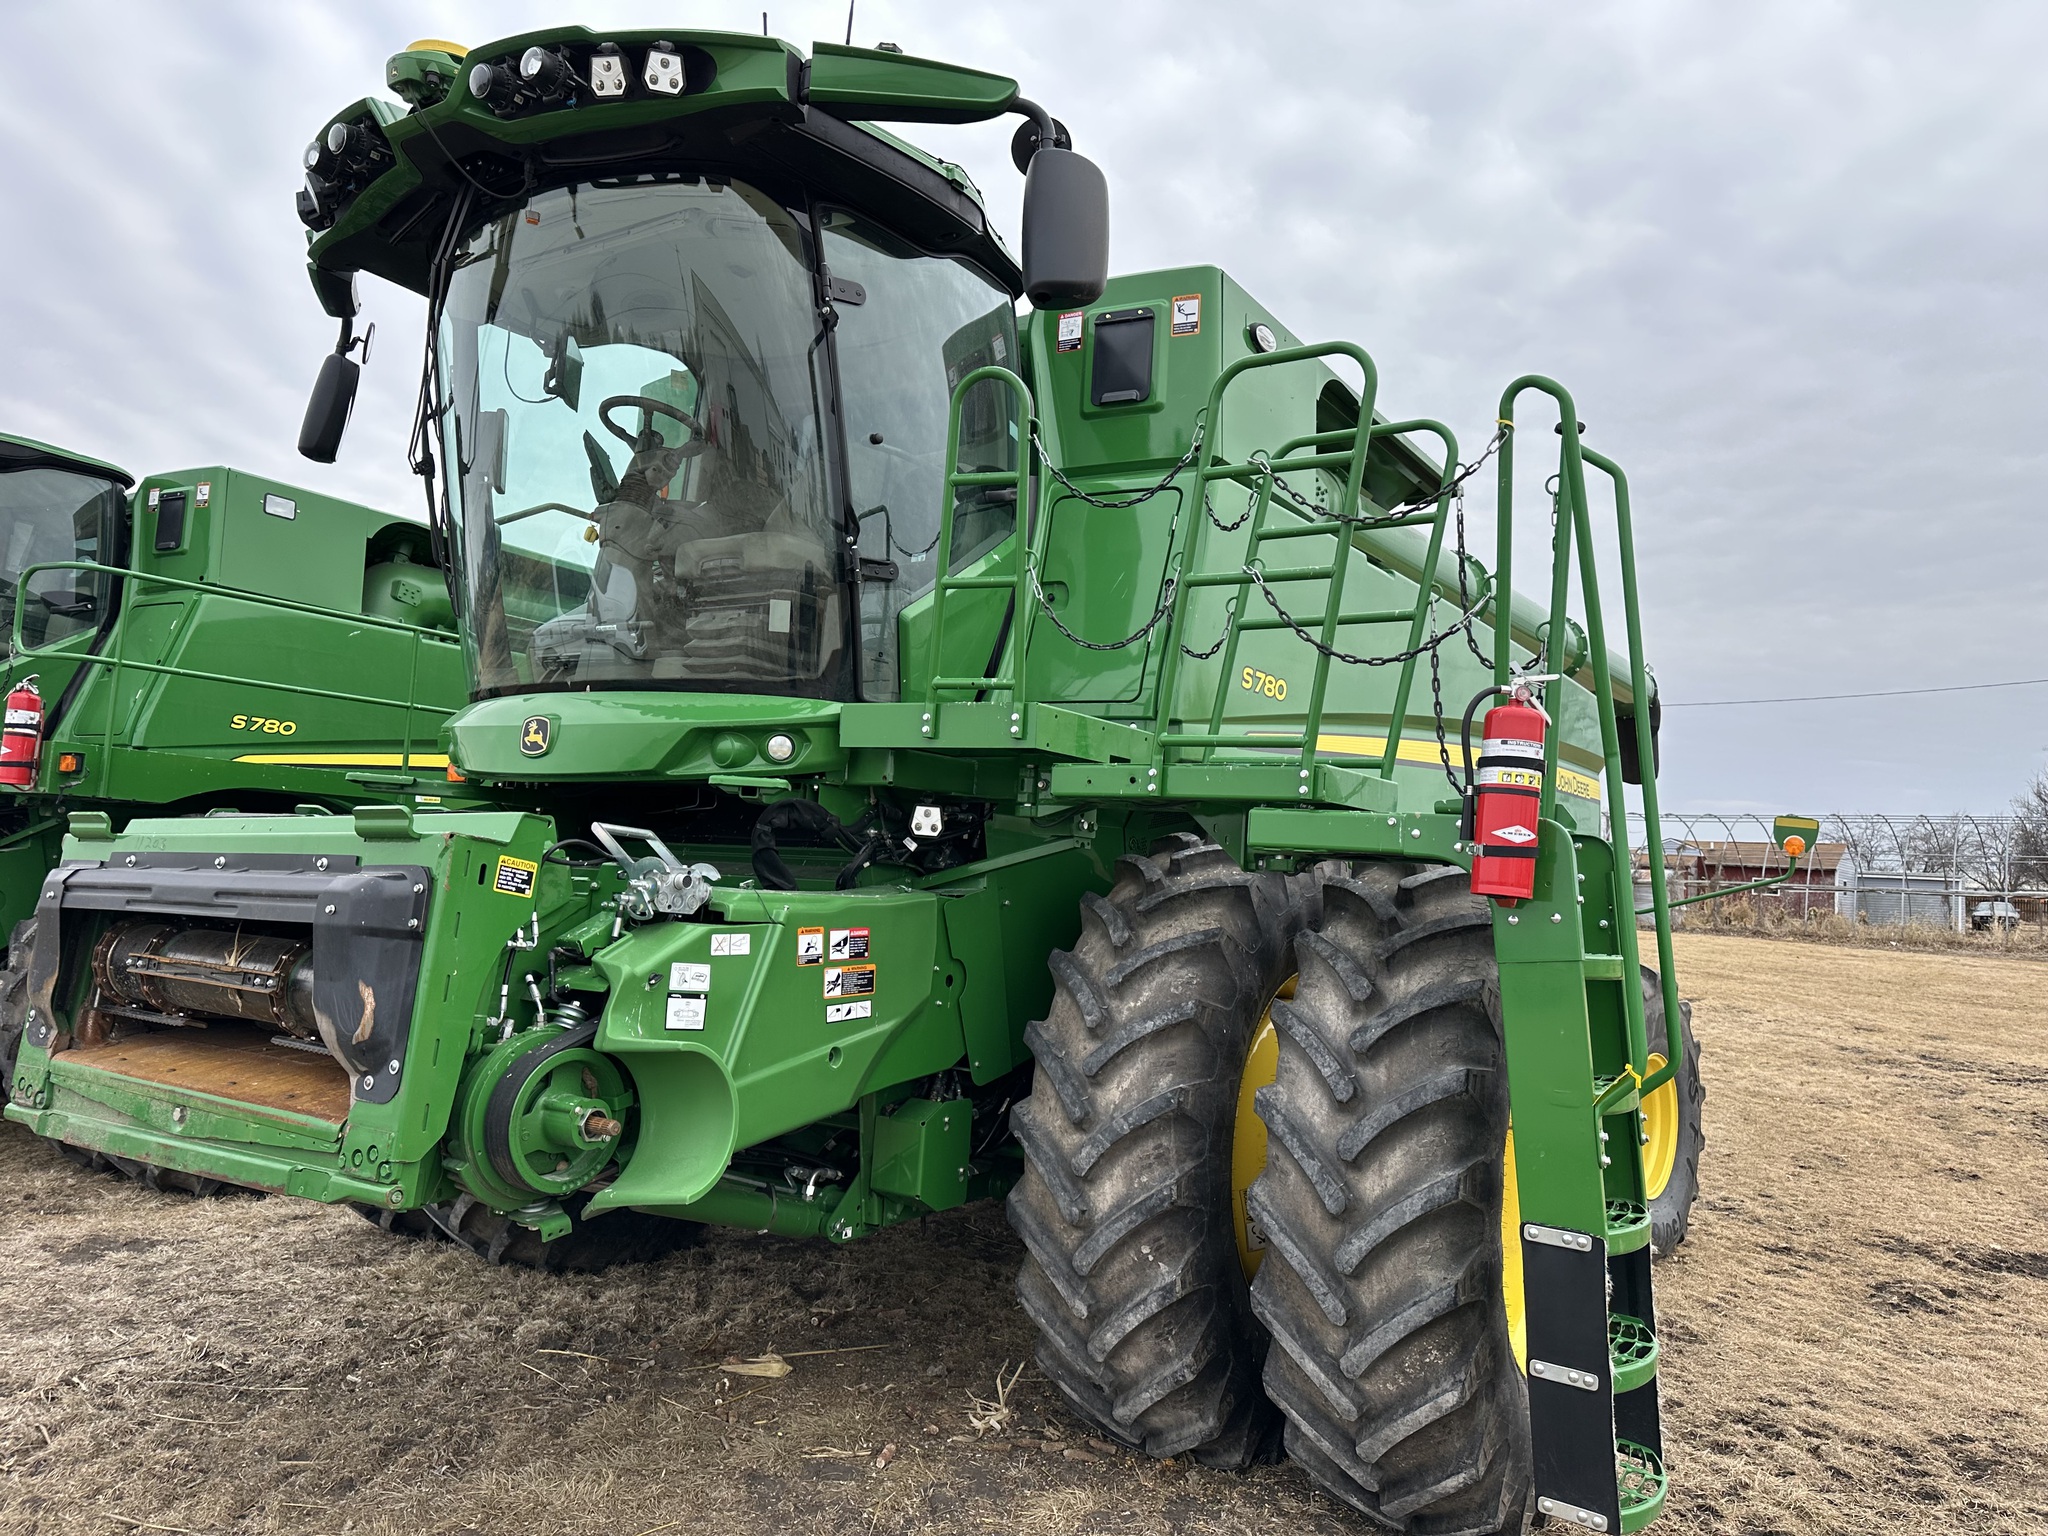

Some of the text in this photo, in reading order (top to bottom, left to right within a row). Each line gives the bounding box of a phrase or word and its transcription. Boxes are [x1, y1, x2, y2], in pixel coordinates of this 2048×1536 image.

[1241, 665, 1288, 702] S780
[229, 714, 298, 737] S780
[1556, 770, 1573, 794] JOHN
[1572, 775, 1591, 799] DEERE
[507, 859, 535, 870] CAUTION
